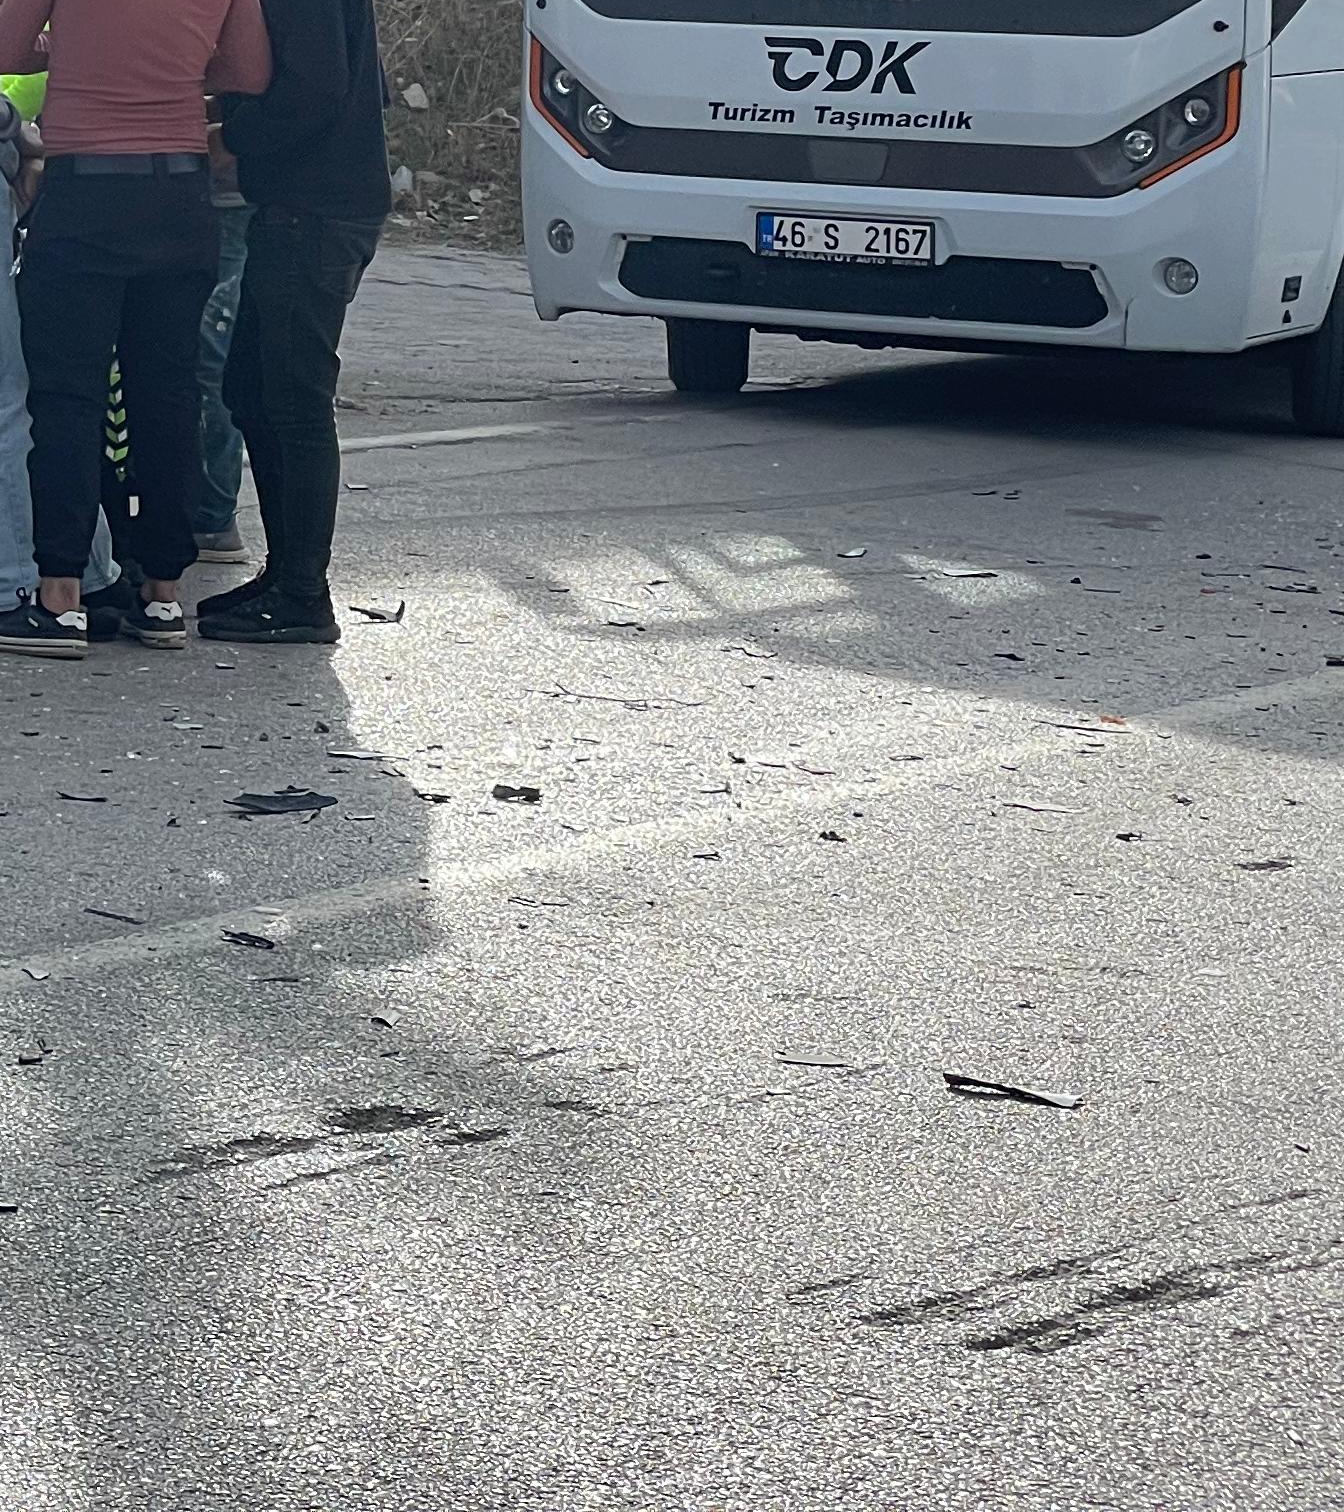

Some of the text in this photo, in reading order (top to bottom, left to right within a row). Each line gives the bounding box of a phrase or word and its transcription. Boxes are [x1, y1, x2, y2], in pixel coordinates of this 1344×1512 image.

[708, 102, 974, 131] Turizm Taşımacılık
[774, 219, 806, 248] 46
[823, 223, 840, 250] S
[864, 225, 928, 256] 2167
